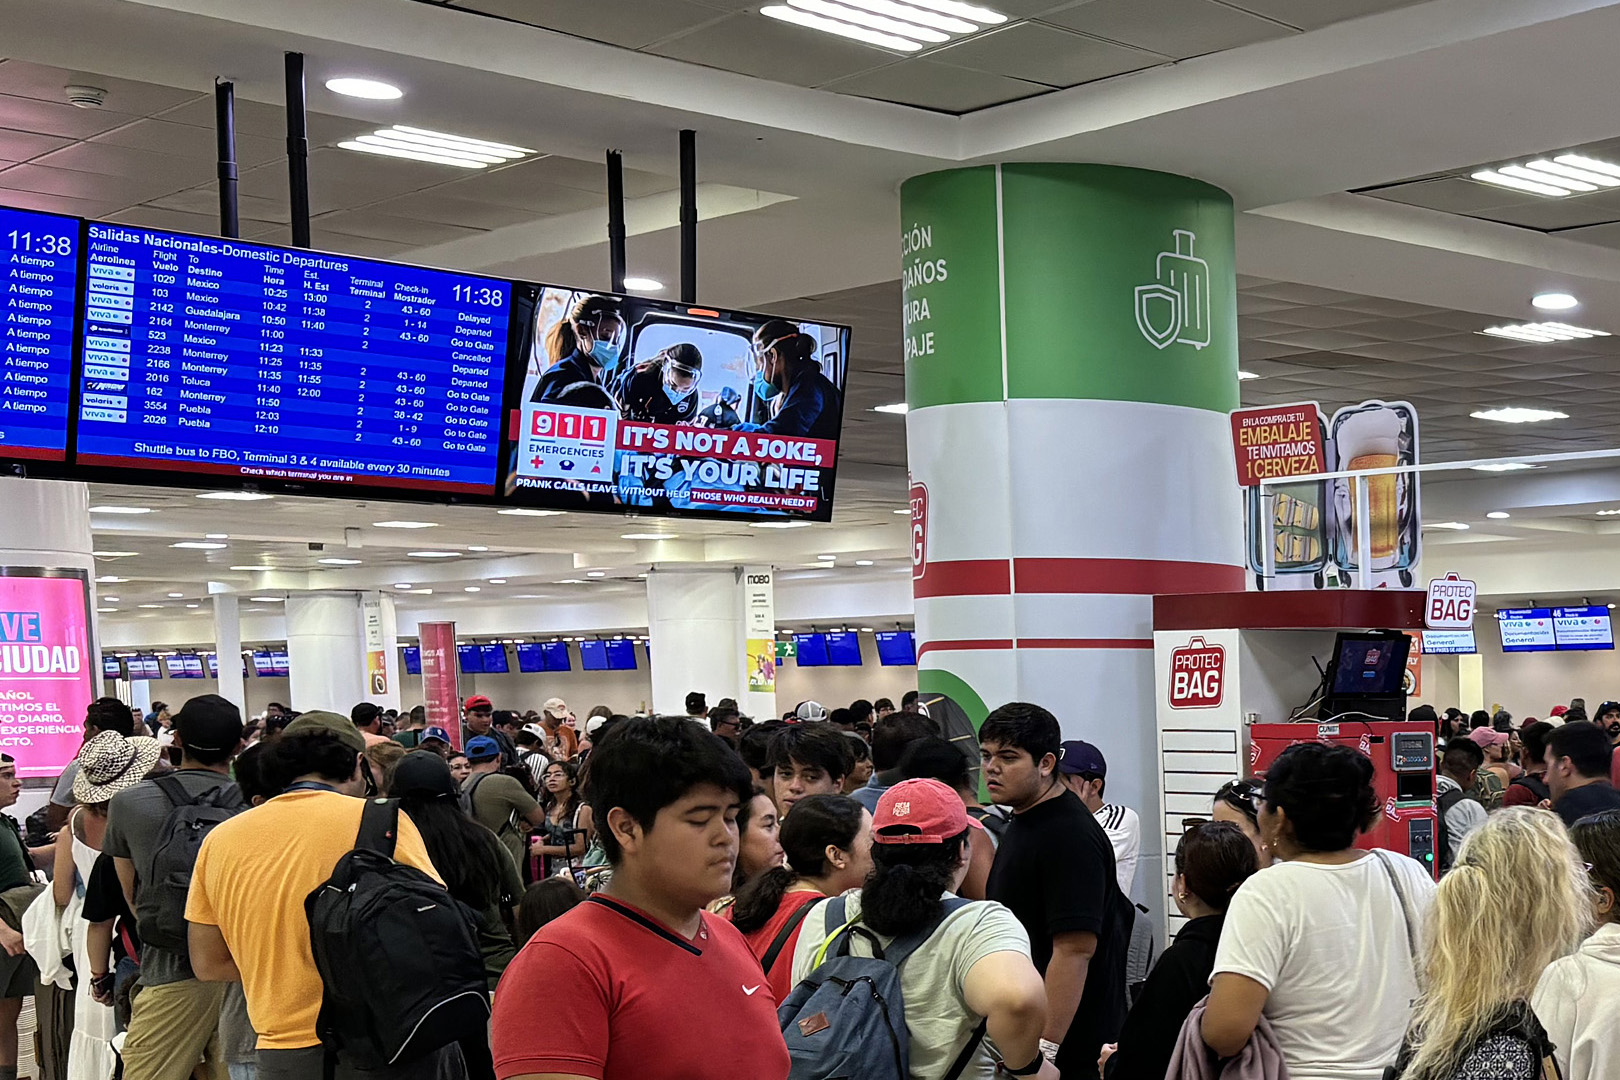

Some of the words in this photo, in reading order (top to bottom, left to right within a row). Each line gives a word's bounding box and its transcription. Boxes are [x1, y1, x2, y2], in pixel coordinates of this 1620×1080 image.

[8, 229, 71, 256] 11:38
[902, 223, 932, 257] CIÓN
[88, 226, 140, 244] Salidas
[283, 253, 349, 272] Departures
[91, 242, 119, 253] Airline
[10, 254, 19, 264] A
[21, 255, 55, 268] tiempo
[153, 251, 178, 262] Flight
[188, 255, 199, 264] To
[153, 261, 179, 273] Vuelo
[188, 265, 223, 278] Destino
[264, 264, 285, 275] Time
[263, 275, 285, 286] Hora
[315, 282, 330, 292] Est
[350, 276, 384, 289] Terminal
[151, 288, 169, 298] 103
[152, 274, 176, 284] 1029
[263, 287, 288, 298] 10:25
[304, 293, 328, 303] 13:00
[349, 286, 386, 299] Terminal
[394, 282, 429, 295] Check-in
[452, 284, 503, 307] 11:38
[393, 292, 437, 306] Mostrador
[150, 302, 174, 313] 2142
[185, 305, 241, 321] Guadalajara
[458, 312, 491, 325] Delayed
[149, 316, 172, 327] 2164
[184, 319, 231, 335] Monterrey
[452, 351, 492, 363] Cancelled
[145, 373, 170, 383] 2016
[180, 375, 211, 387] Toluca
[1260, 415, 1287, 425] COMPRA
[1287, 414, 1296, 422] DE
[1296, 412, 1305, 421] TU
[1240, 421, 1312, 446] EMBALAJE
[529, 444, 605, 458] EMERGENCIES
[622, 425, 670, 449] IT'S
[675, 431, 728, 453] NOT
[731, 437, 750, 456] A
[755, 438, 823, 466] JOKE,
[1247, 445, 1260, 460] TE
[1260, 441, 1315, 459] INVITAMOS
[134, 442, 173, 455] Shuttle
[175, 445, 196, 457] bus
[199, 448, 209, 458] to
[243, 451, 288, 464] Terminal
[290, 455, 297, 465] 3
[300, 456, 308, 465] &
[310, 456, 317, 466] 4
[319, 458, 365, 470] available
[367, 464, 395, 474] every
[397, 464, 410, 474] 30
[412, 465, 450, 477] minutes
[620, 454, 674, 480] IT'S
[680, 459, 758, 487] YOUR
[764, 465, 820, 491] LIFE
[1246, 461, 1252, 479] 1
[1254, 455, 1319, 478] CERVEZA
[516, 478, 552, 489] PRANK
[554, 481, 586, 491] CALLS
[586, 483, 618, 494] LEAVE
[621, 487, 665, 498] WITHOUT
[666, 488, 690, 499] HELP
[692, 491, 721, 501] THOSE
[723, 494, 746, 503] WHO
[748, 496, 781, 505] REALLY
[781, 498, 805, 507] NEED
[806, 499, 815, 508] IT
[1432, 585, 1472, 598] PROTEC
[1431, 599, 1471, 621] BAG
[0, 645, 80, 674] IUDAD
[1175, 652, 1221, 670] PROTEC
[1173, 669, 1219, 700] BAG
[45, 703, 60, 711] EL
[18, 714, 65, 723] DIARIO,
[1, 725, 81, 735] EXPERIENCIA
